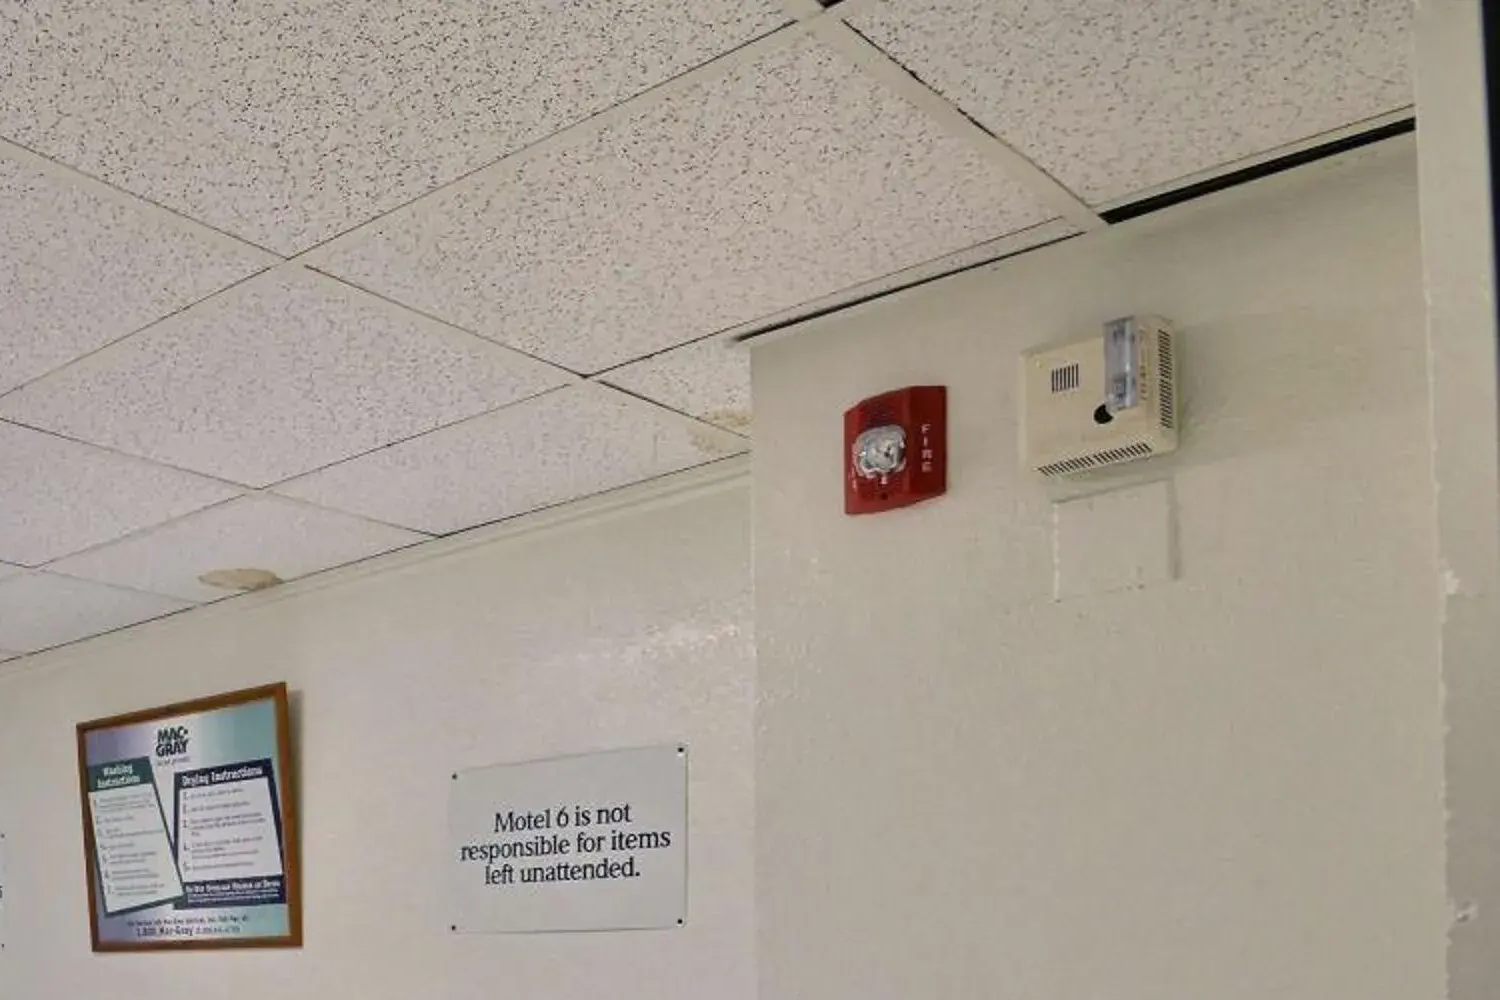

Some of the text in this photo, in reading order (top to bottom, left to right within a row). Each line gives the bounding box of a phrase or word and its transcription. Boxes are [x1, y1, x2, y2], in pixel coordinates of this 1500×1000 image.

[921, 423, 933, 473] FIRE
[156, 740, 189, 757] GRAY
[494, 804, 632, 833] Motel 6 is not
[460, 830, 671, 864] responsible for items
[484, 856, 641, 885] left unattended.
